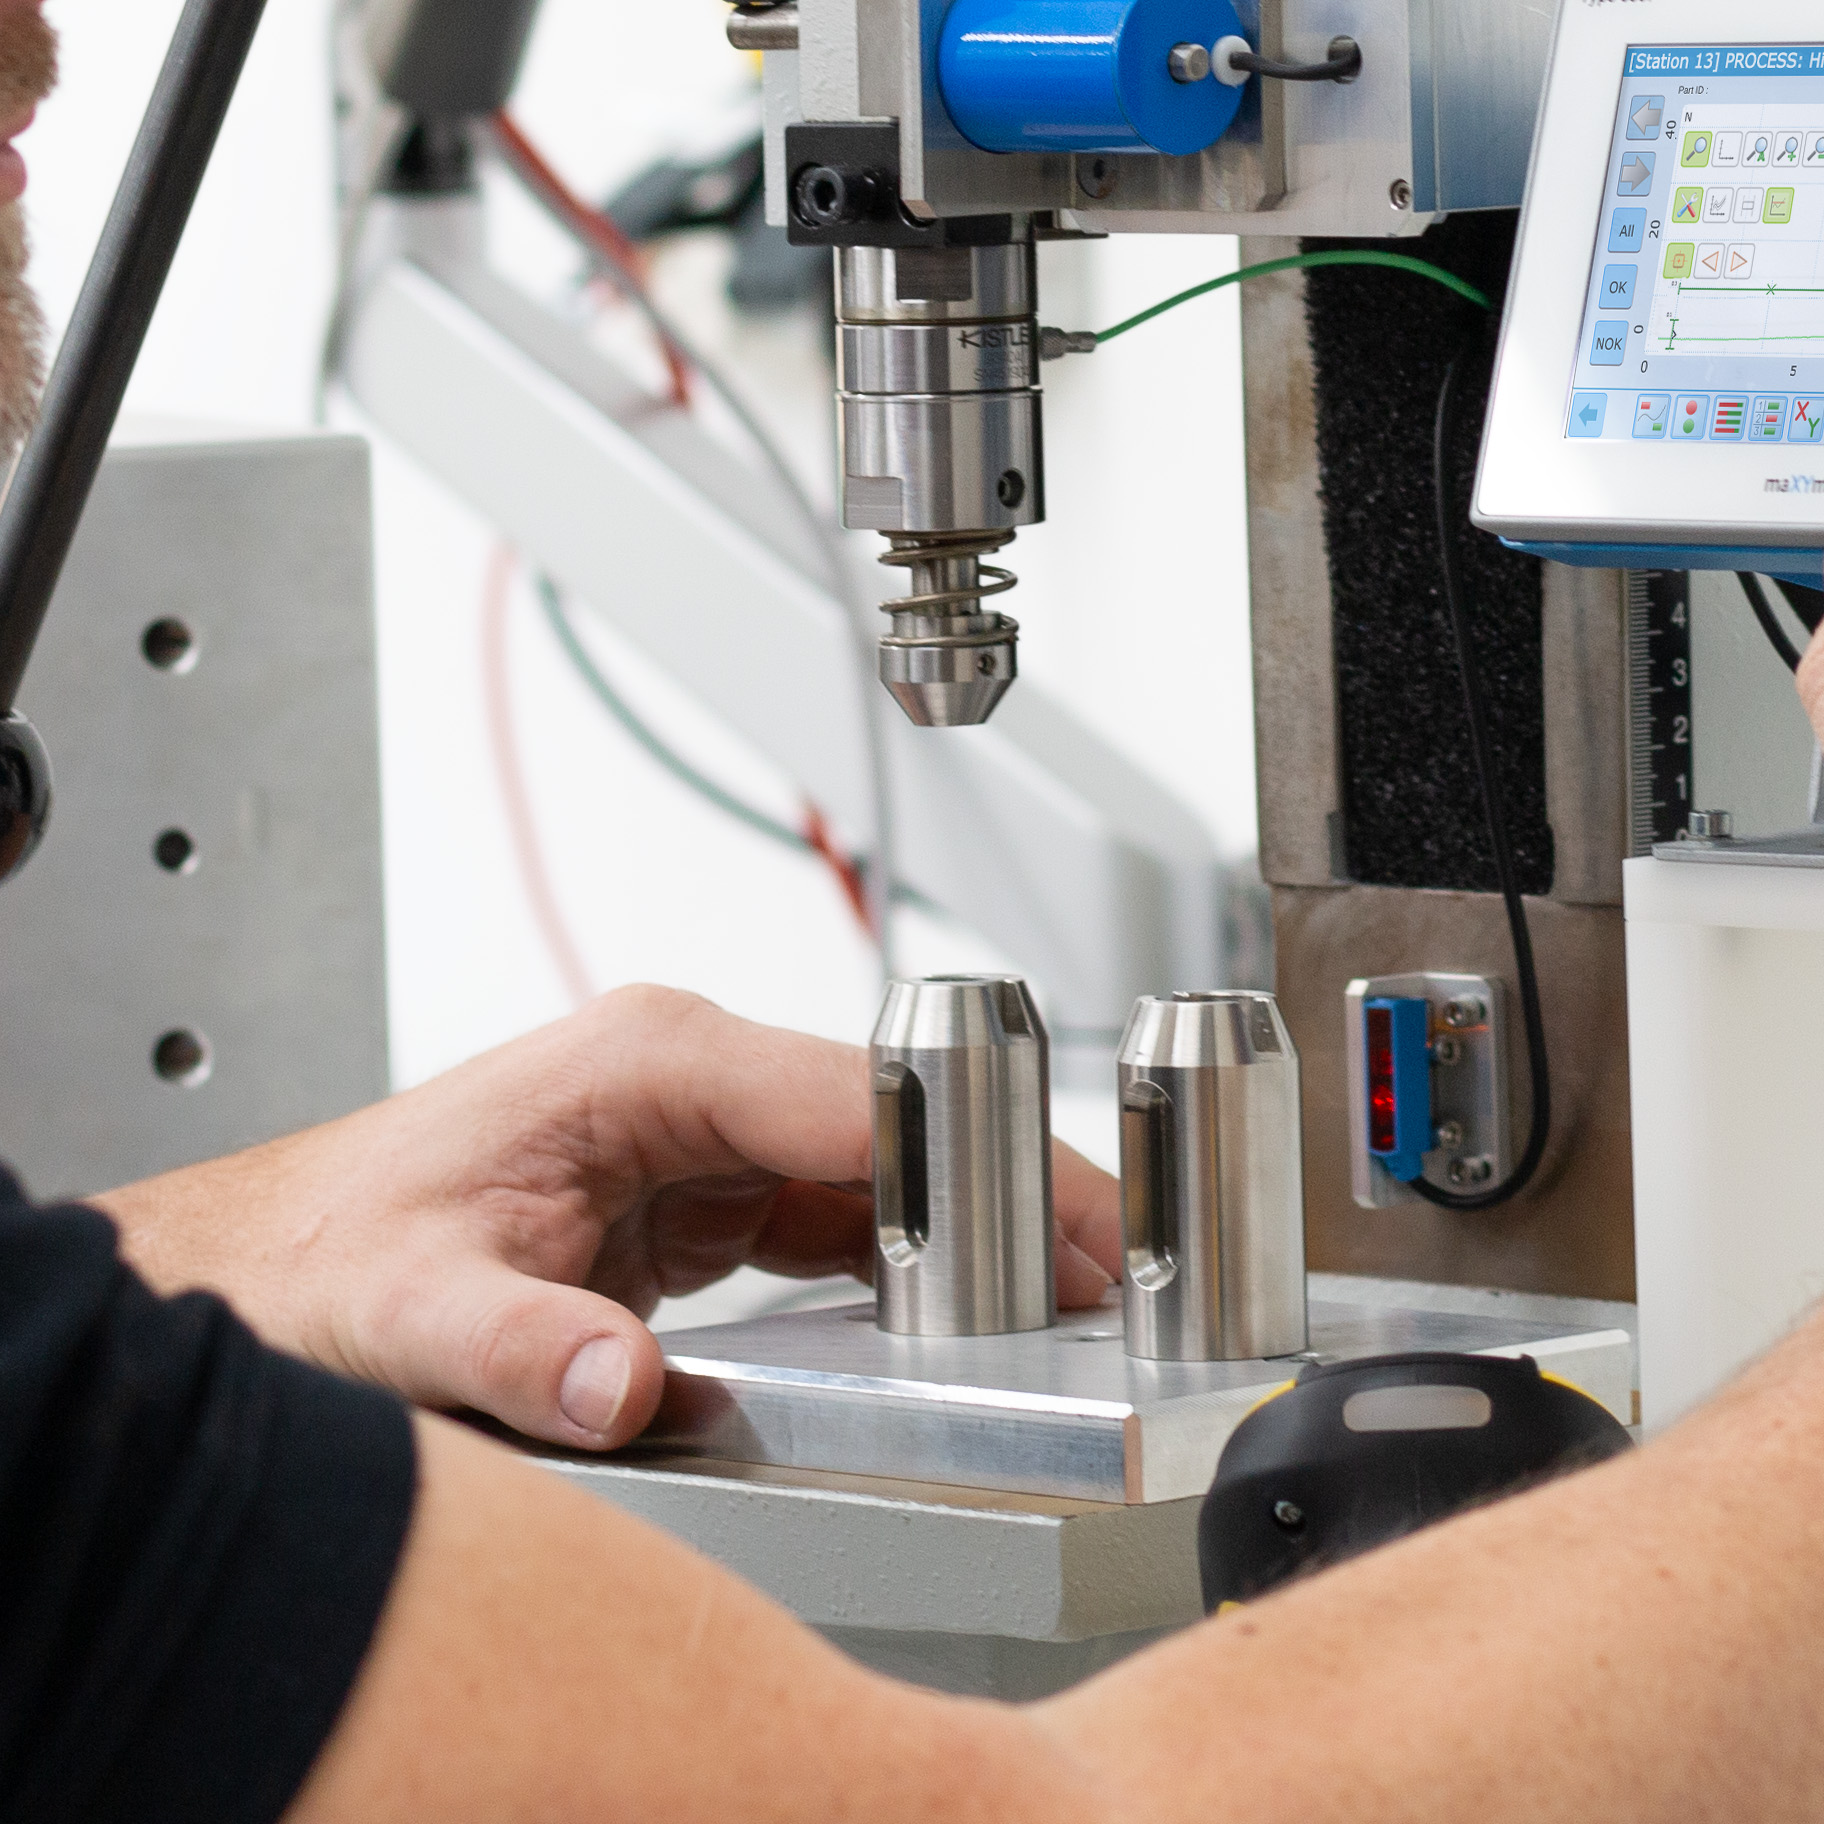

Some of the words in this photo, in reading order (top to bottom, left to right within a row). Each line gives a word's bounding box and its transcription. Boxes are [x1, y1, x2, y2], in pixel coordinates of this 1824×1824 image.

[1628, 52, 1689, 73] [Station
[1695, 52, 1720, 72] 13]
[1726, 52, 1804, 70] PROCESS:
[1678, 86, 1694, 94] Part
[1695, 86, 1704, 94] ID
[1684, 112, 1692, 122] N
[1666, 120, 1677, 139] 40
[1619, 224, 1635, 237] All
[1649, 220, 1661, 238] 20
[1609, 281, 1627, 294] OK
[956, 326, 1033, 348] KISTLE
[1634, 325, 1644, 334] 0
[1596, 337, 1623, 350] NOK
[1640, 360, 1648, 373] 0
[1789, 365, 1797, 377] 5
[1670, 601, 1686, 628] 4
[1672, 659, 1687, 687] 3
[1673, 716, 1688, 743] 2
[1676, 774, 1687, 800] 1
